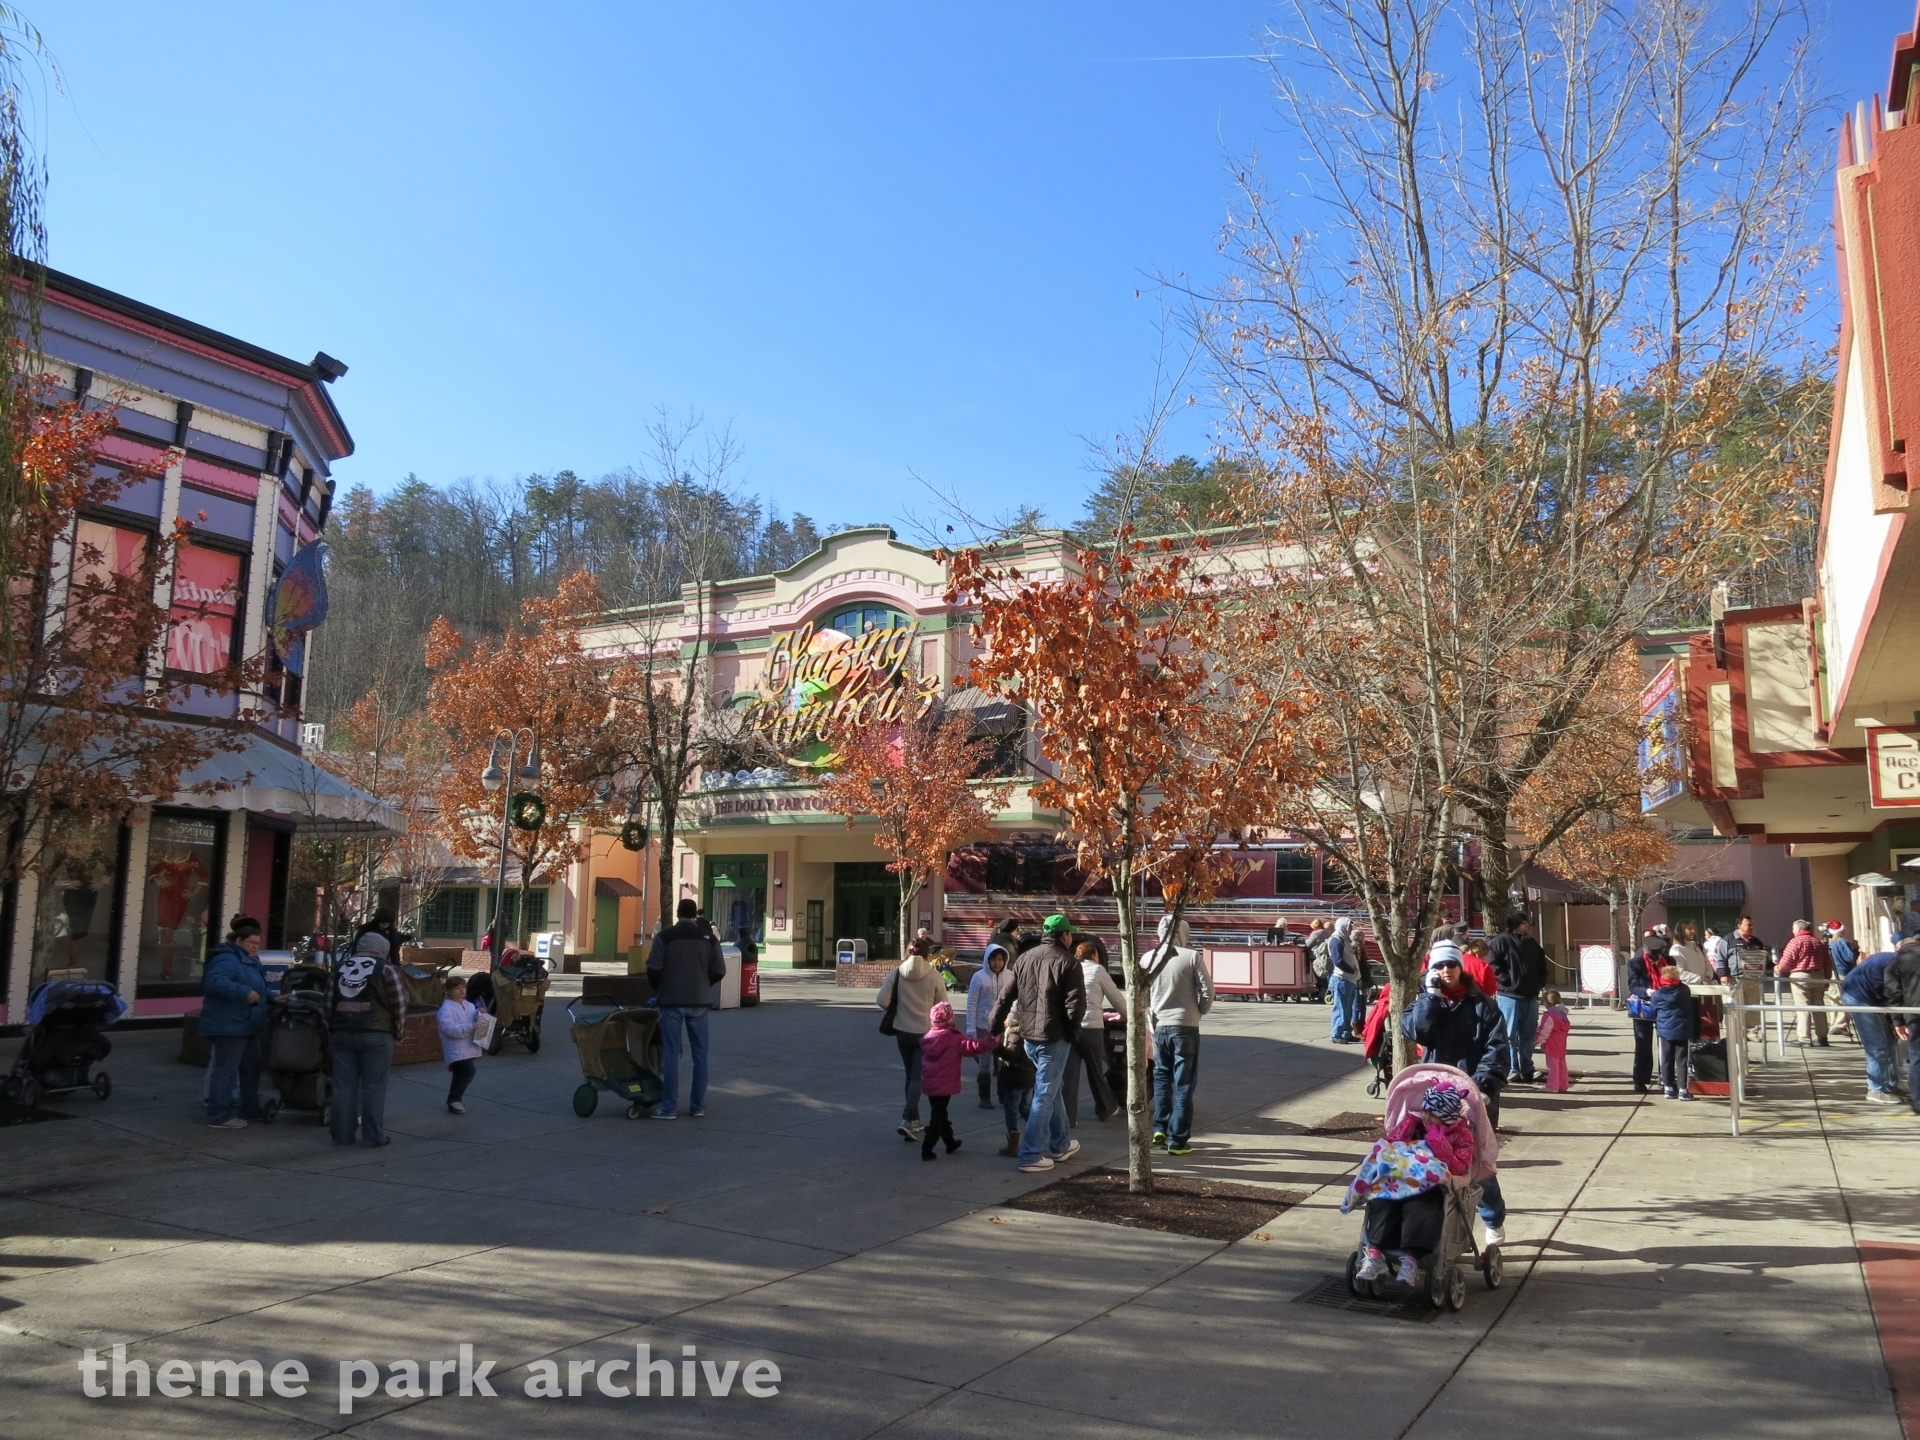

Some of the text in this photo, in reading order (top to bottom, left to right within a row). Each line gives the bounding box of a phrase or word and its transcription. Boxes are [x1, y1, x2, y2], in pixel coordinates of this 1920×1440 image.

[763, 621, 920, 695] Chasing
[715, 801, 733, 815] THE
[735, 799, 775, 813] DOLLY
[776, 797, 831, 812] PARTON
